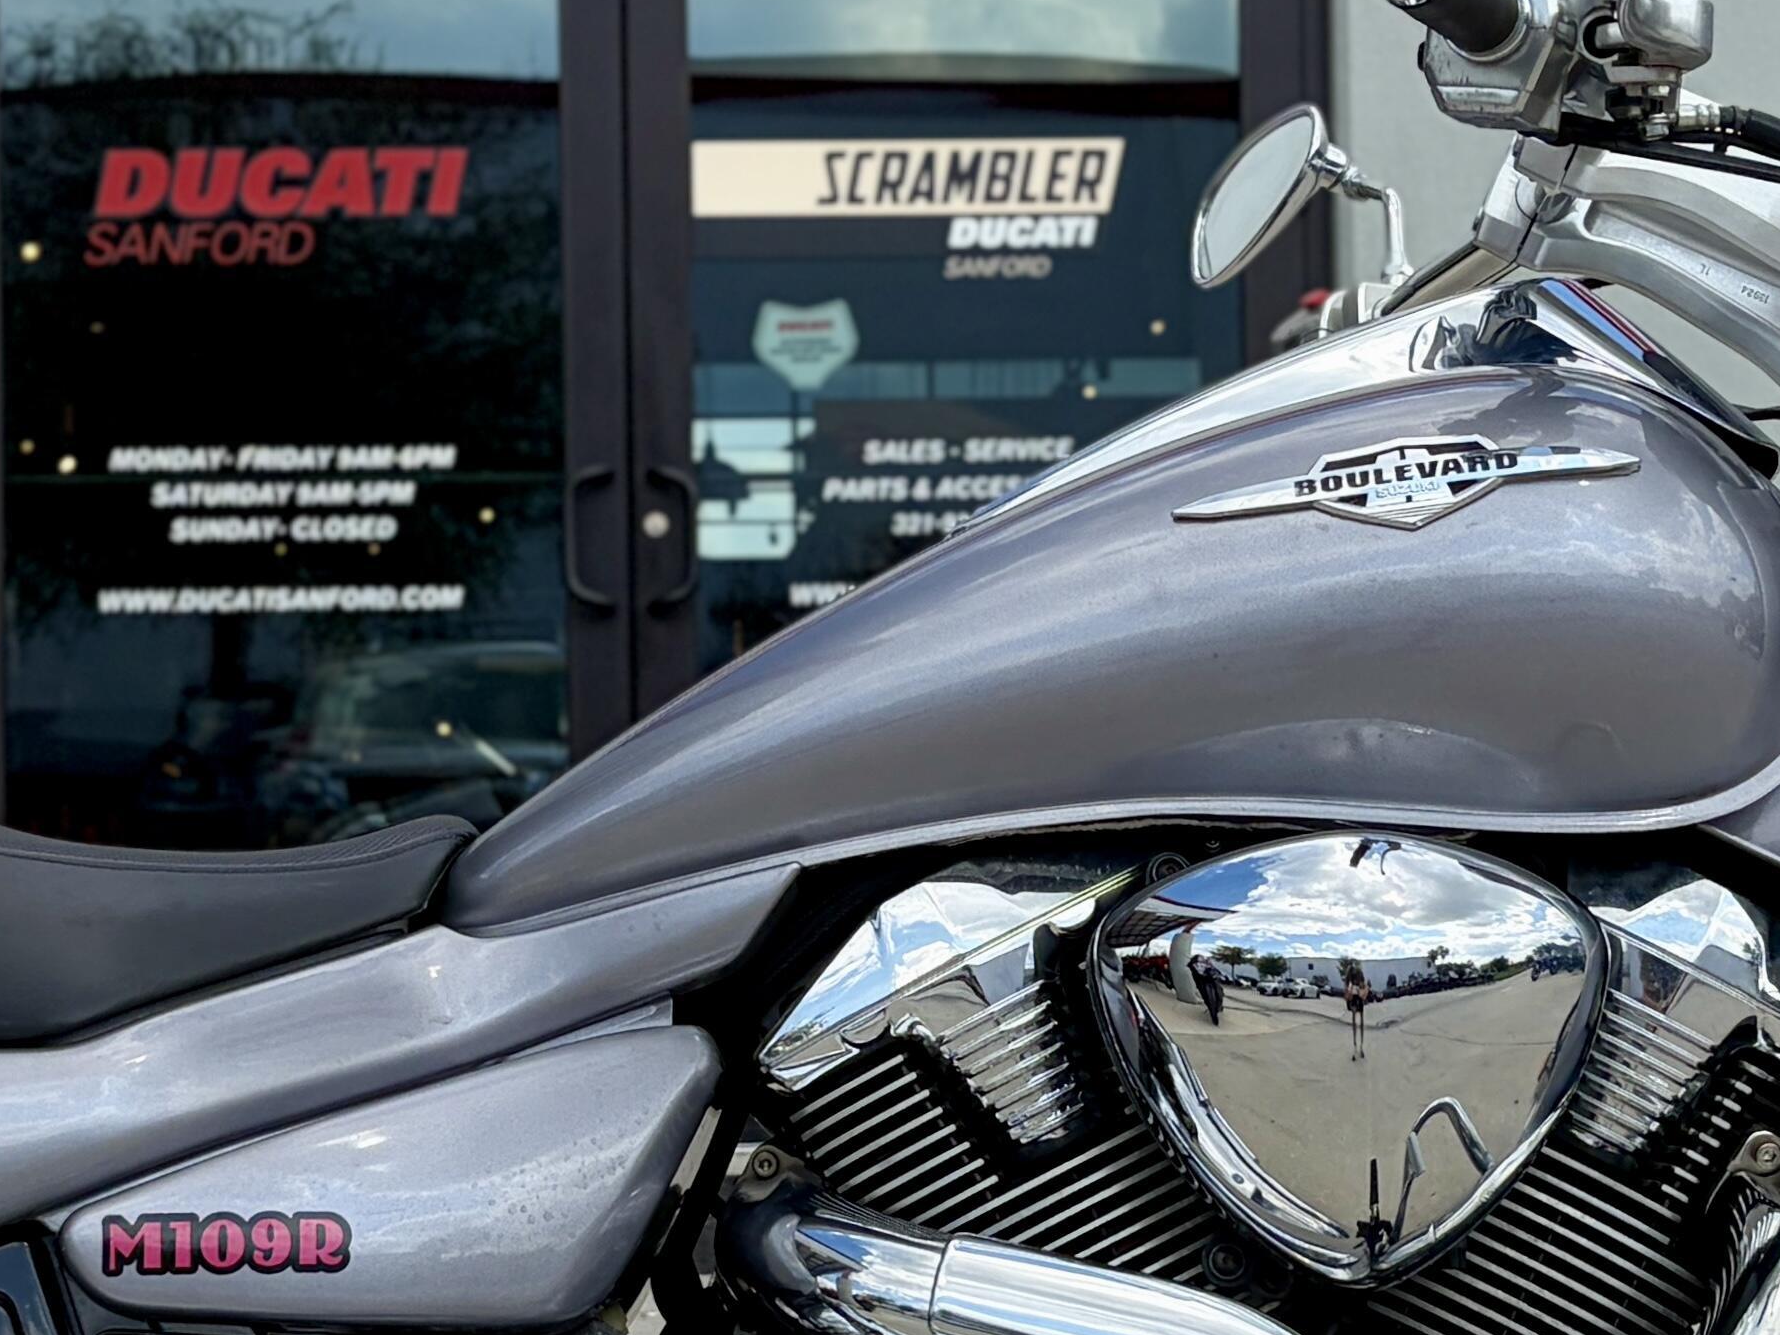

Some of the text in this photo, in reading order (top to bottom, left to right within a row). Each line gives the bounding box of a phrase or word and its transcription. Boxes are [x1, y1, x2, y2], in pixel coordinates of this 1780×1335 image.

[94, 146, 469, 217] DUCATI
[816, 149, 1108, 206] SCRAMBLER
[84, 222, 315, 266] SANFORD
[947, 216, 1098, 249] DUCATI
[944, 255, 1052, 279] SANFORD
[236, 445, 335, 471] FRIDAY
[863, 438, 946, 464] SALES
[964, 436, 1074, 463] SERVICE
[1293, 449, 1520, 497] BOULEVARD
[150, 481, 294, 508] SATURDAY
[822, 476, 909, 502] PARTS
[1374, 480, 1441, 499] SUZUKI
[290, 515, 399, 542] CLOSED
[98, 585, 465, 614] WWW.DUCATISANFORD.COM
[104, 1213, 351, 1274] M109R
